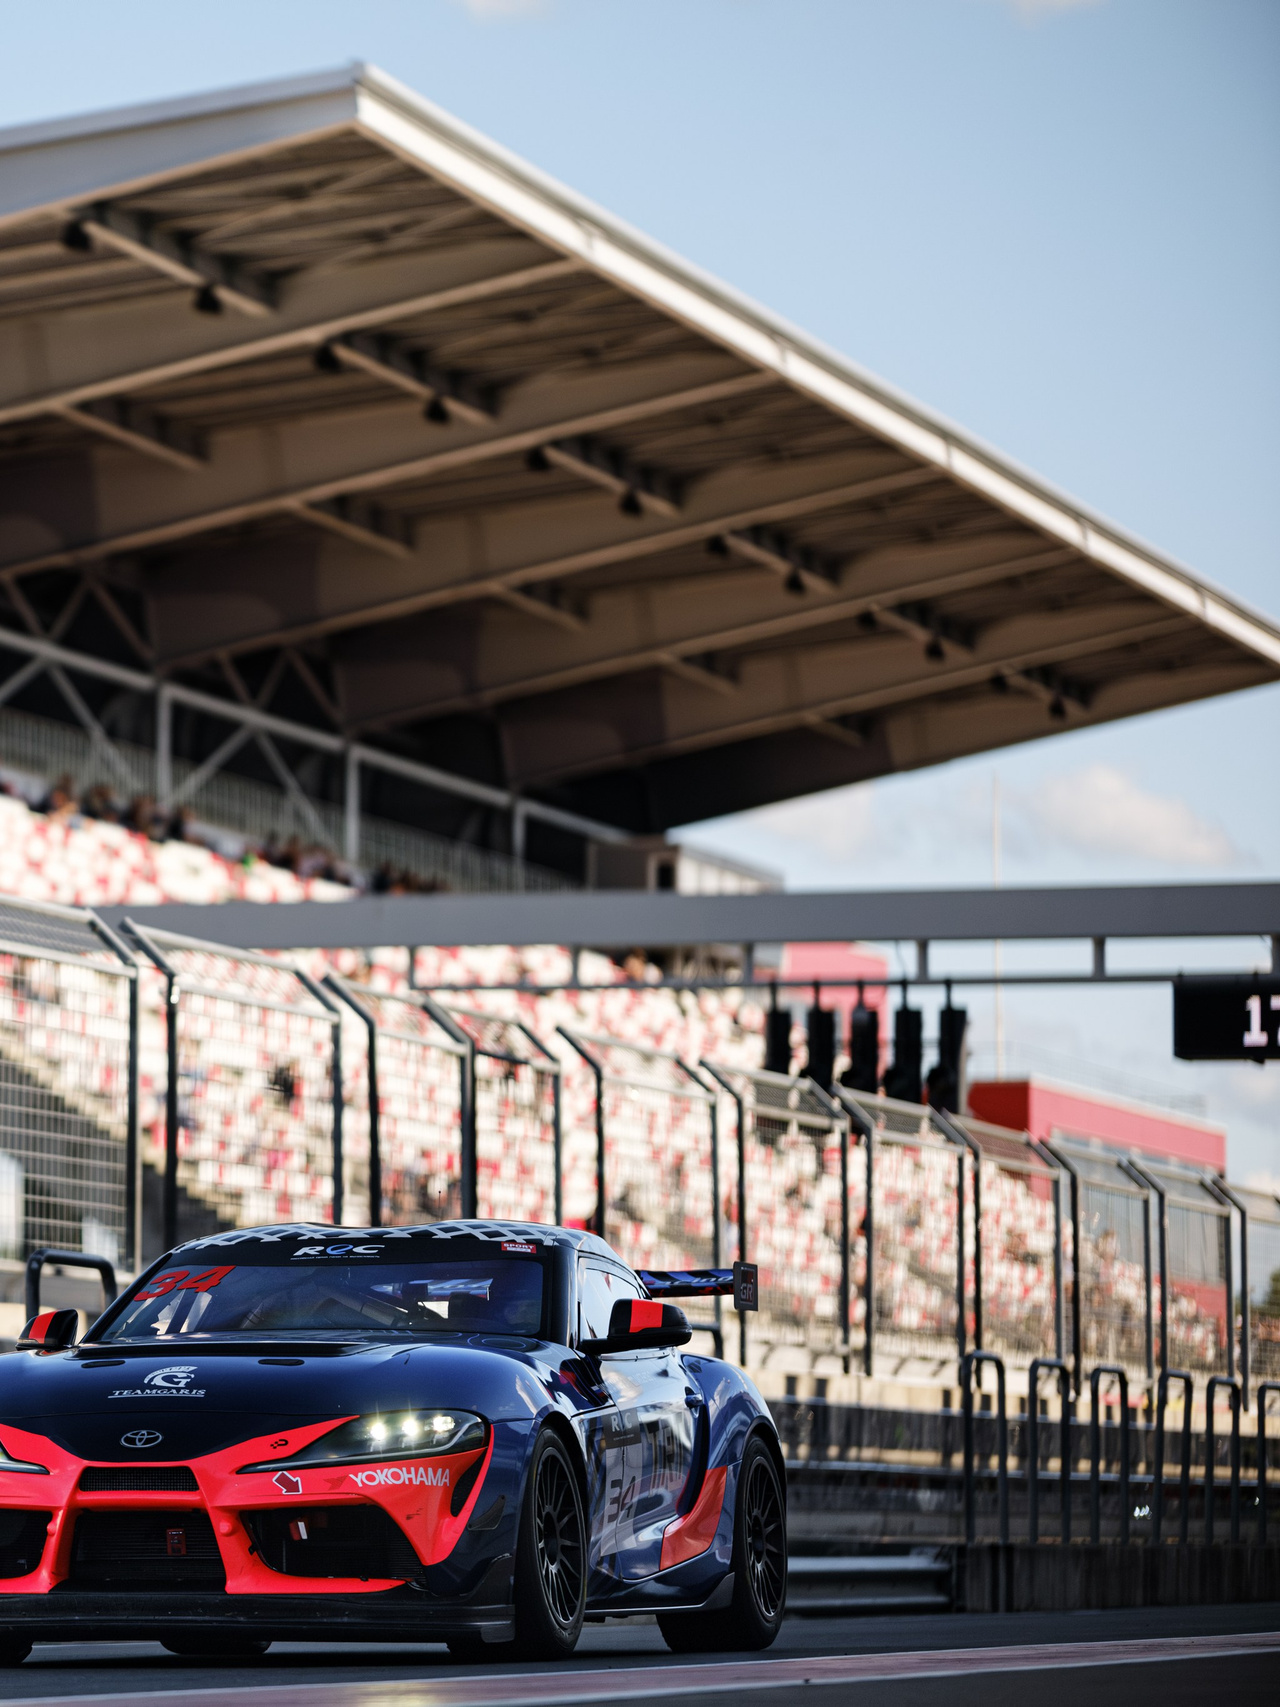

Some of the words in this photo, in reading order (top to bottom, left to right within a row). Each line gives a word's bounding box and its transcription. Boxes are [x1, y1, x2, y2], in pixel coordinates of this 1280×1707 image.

[133, 1265, 237, 1302] 34
[740, 1282, 754, 1301] GR
[112, 1388, 207, 1396] TEAMGARIS
[611, 1412, 633, 1433] RC
[348, 1466, 451, 1488] YOKOHAMA
[607, 1475, 637, 1524] 34
